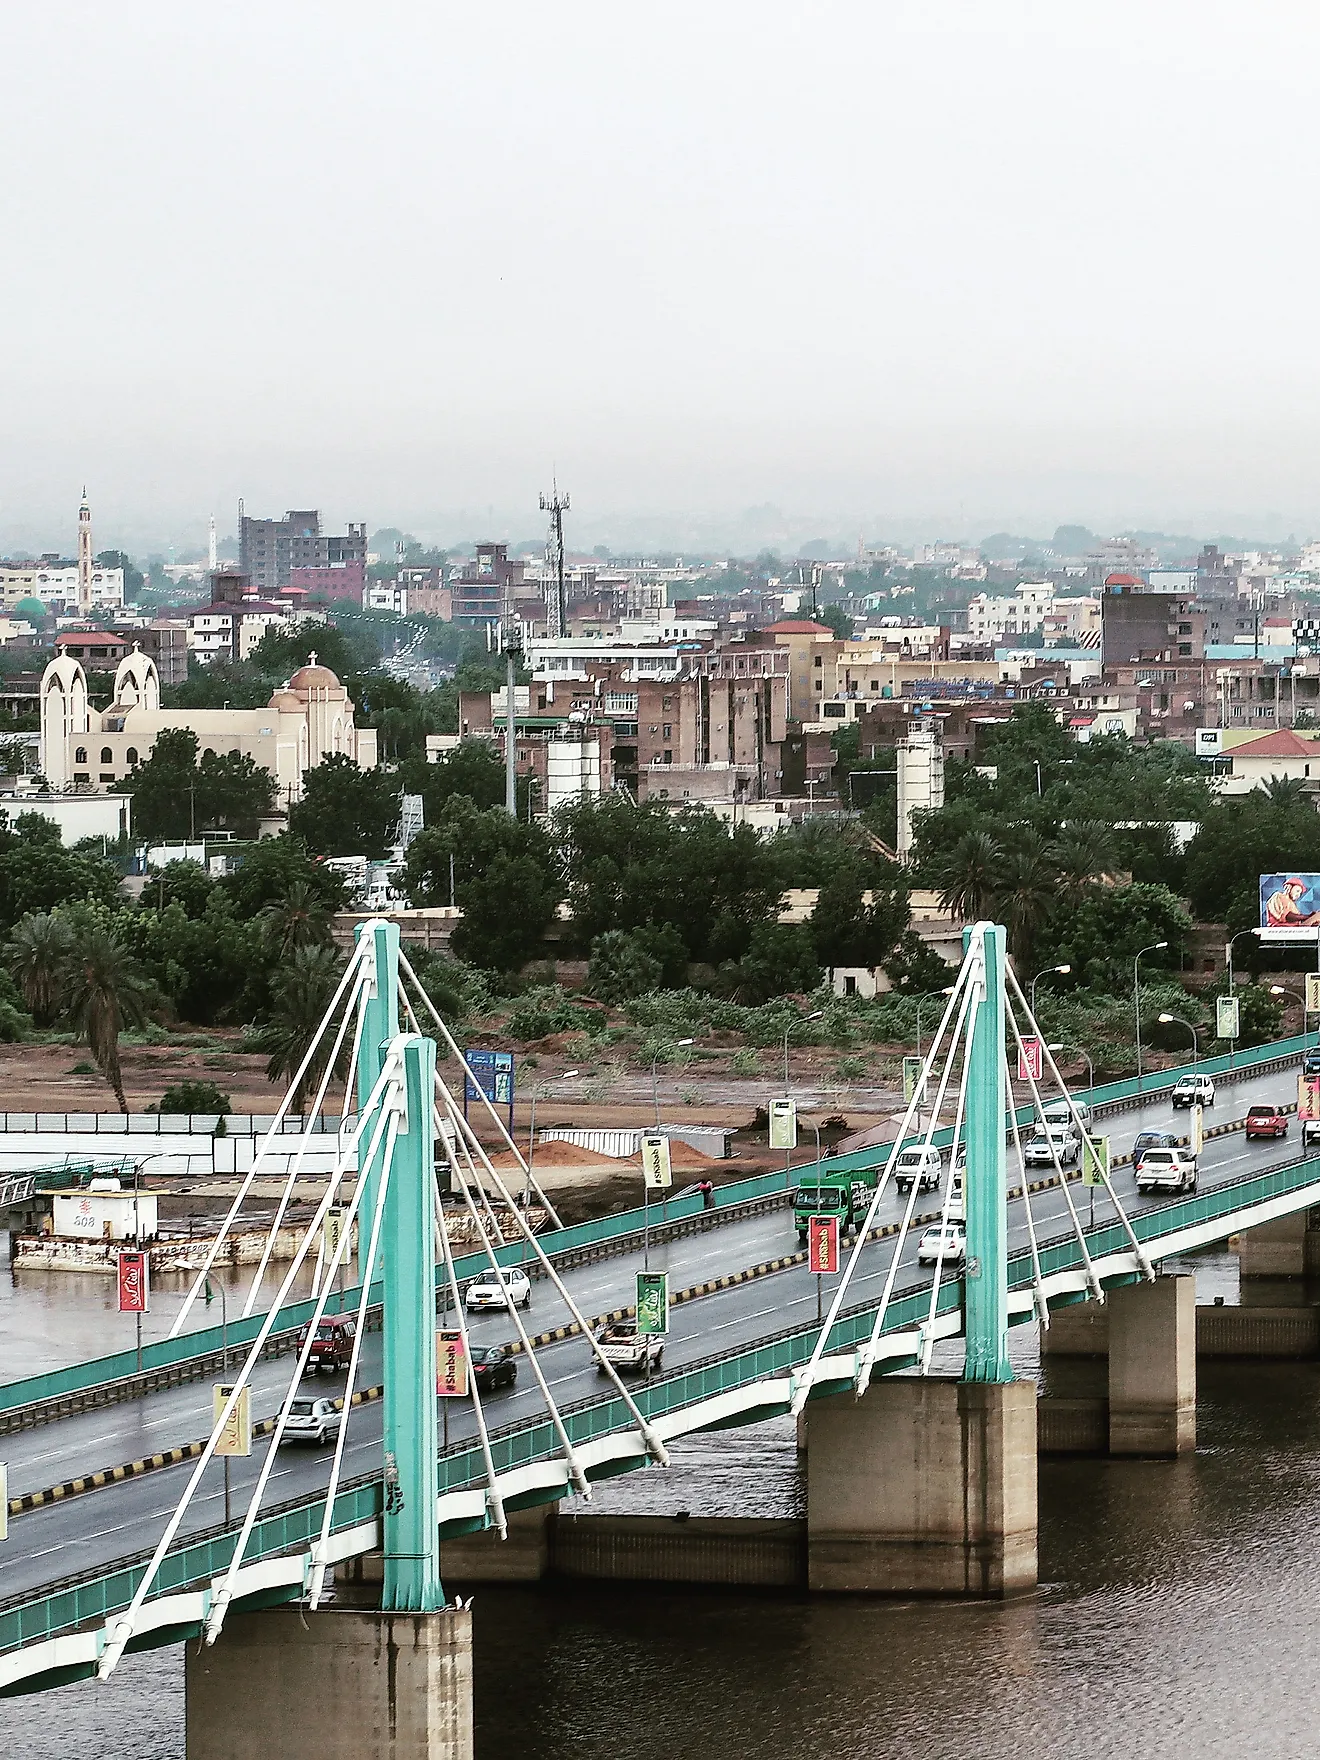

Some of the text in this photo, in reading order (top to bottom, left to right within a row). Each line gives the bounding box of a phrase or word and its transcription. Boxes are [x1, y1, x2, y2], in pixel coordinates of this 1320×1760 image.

[654, 1149, 663, 1185] #Shabab
[820, 1228, 829, 1270] #Shabab
[445, 1344, 456, 1392] #Shabab
